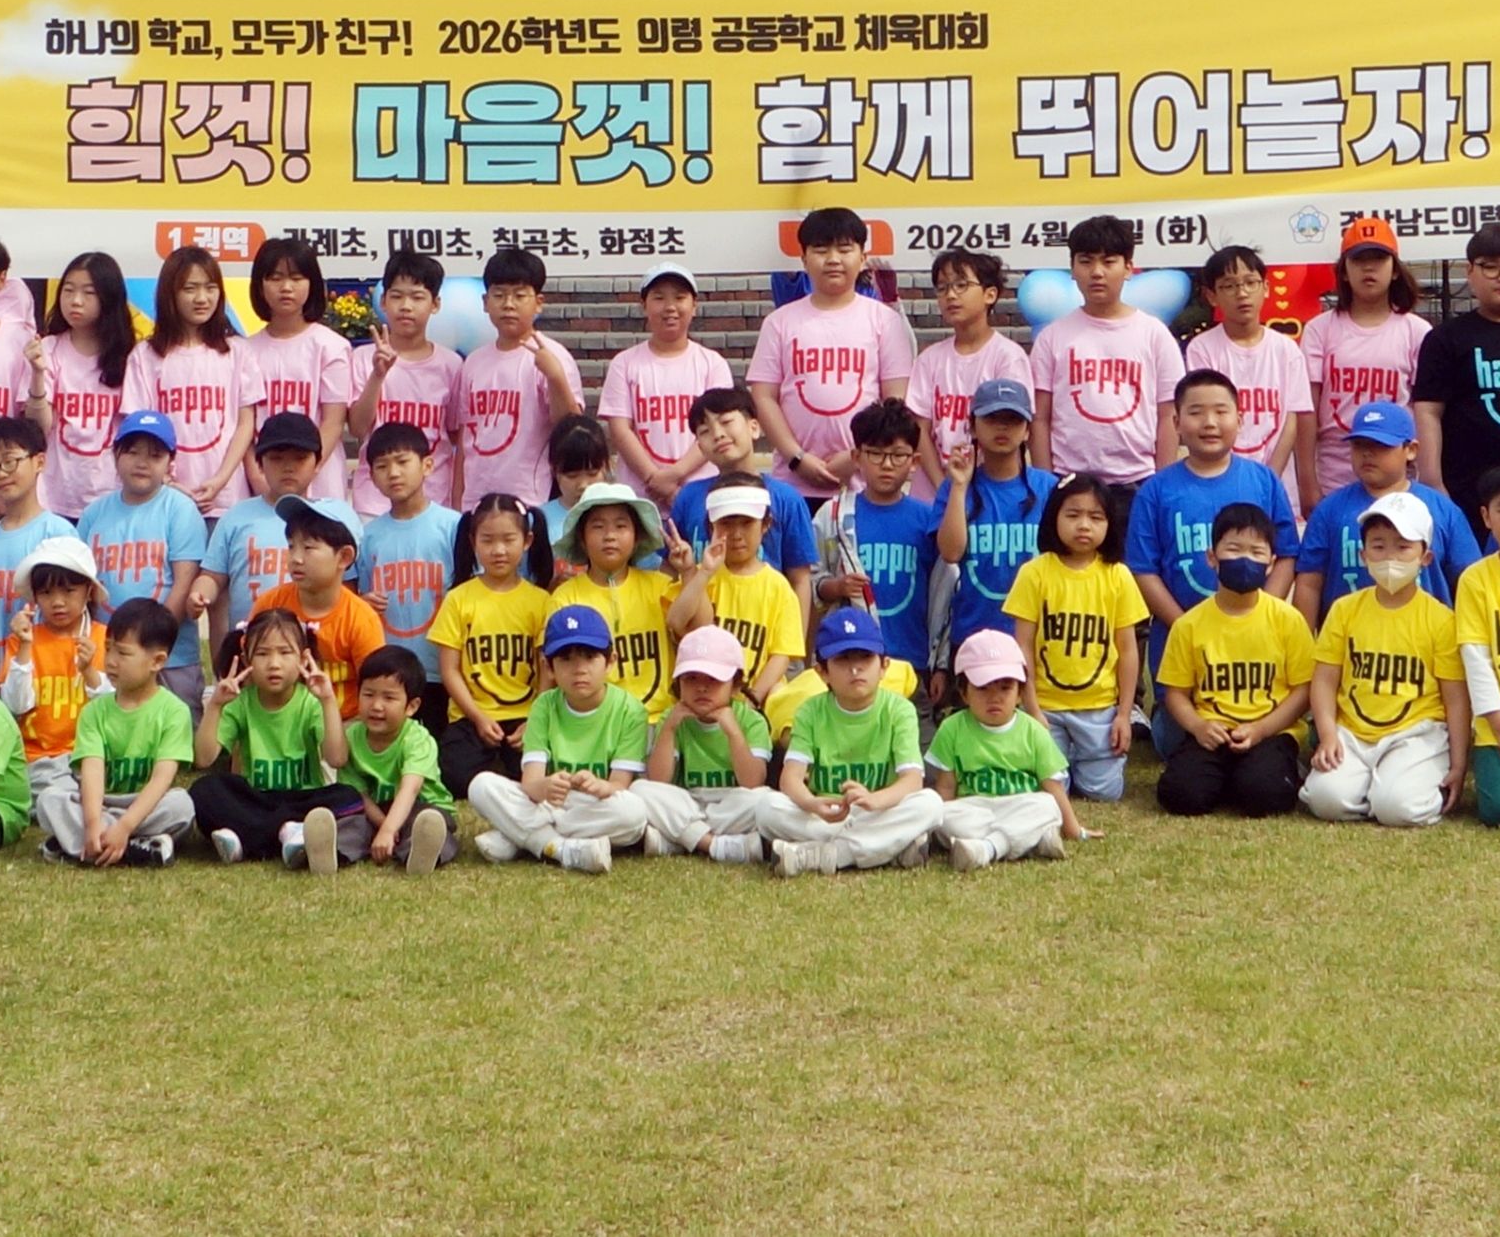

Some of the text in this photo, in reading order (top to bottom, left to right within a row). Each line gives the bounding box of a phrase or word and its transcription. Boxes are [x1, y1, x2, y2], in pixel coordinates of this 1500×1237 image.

[45, 12, 988, 60] 하나의 학교, 모두가 친구! 2026학년도 의령 공동학교 체육대회
[67, 60, 1491, 188] 힘껏! 마음껏! 함께 뛰어놀자!
[168, 226, 249, 257] 1 권역
[387, 226, 483, 260] 대의초,
[598, 225, 687, 256] 화정초
[906, 222, 1011, 251] 2026년
[1021, 220, 1070, 248] 4월
[1156, 214, 1208, 246] (화)
[792, 338, 866, 384] happy
[1070, 347, 1142, 395] happy
[1329, 354, 1400, 404] happy
[157, 377, 227, 423] happy
[264, 380, 311, 418] ppy
[636, 383, 699, 432] happ
[1237, 388, 1280, 424] ppy
[93, 535, 166, 584] happy
[858, 542, 917, 585] appy
[466, 623, 536, 676] happy
[1044, 599, 1108, 657] happy
[613, 631, 660, 679] ppy
[1349, 638, 1426, 695] happy
[34, 675, 86, 720] app
